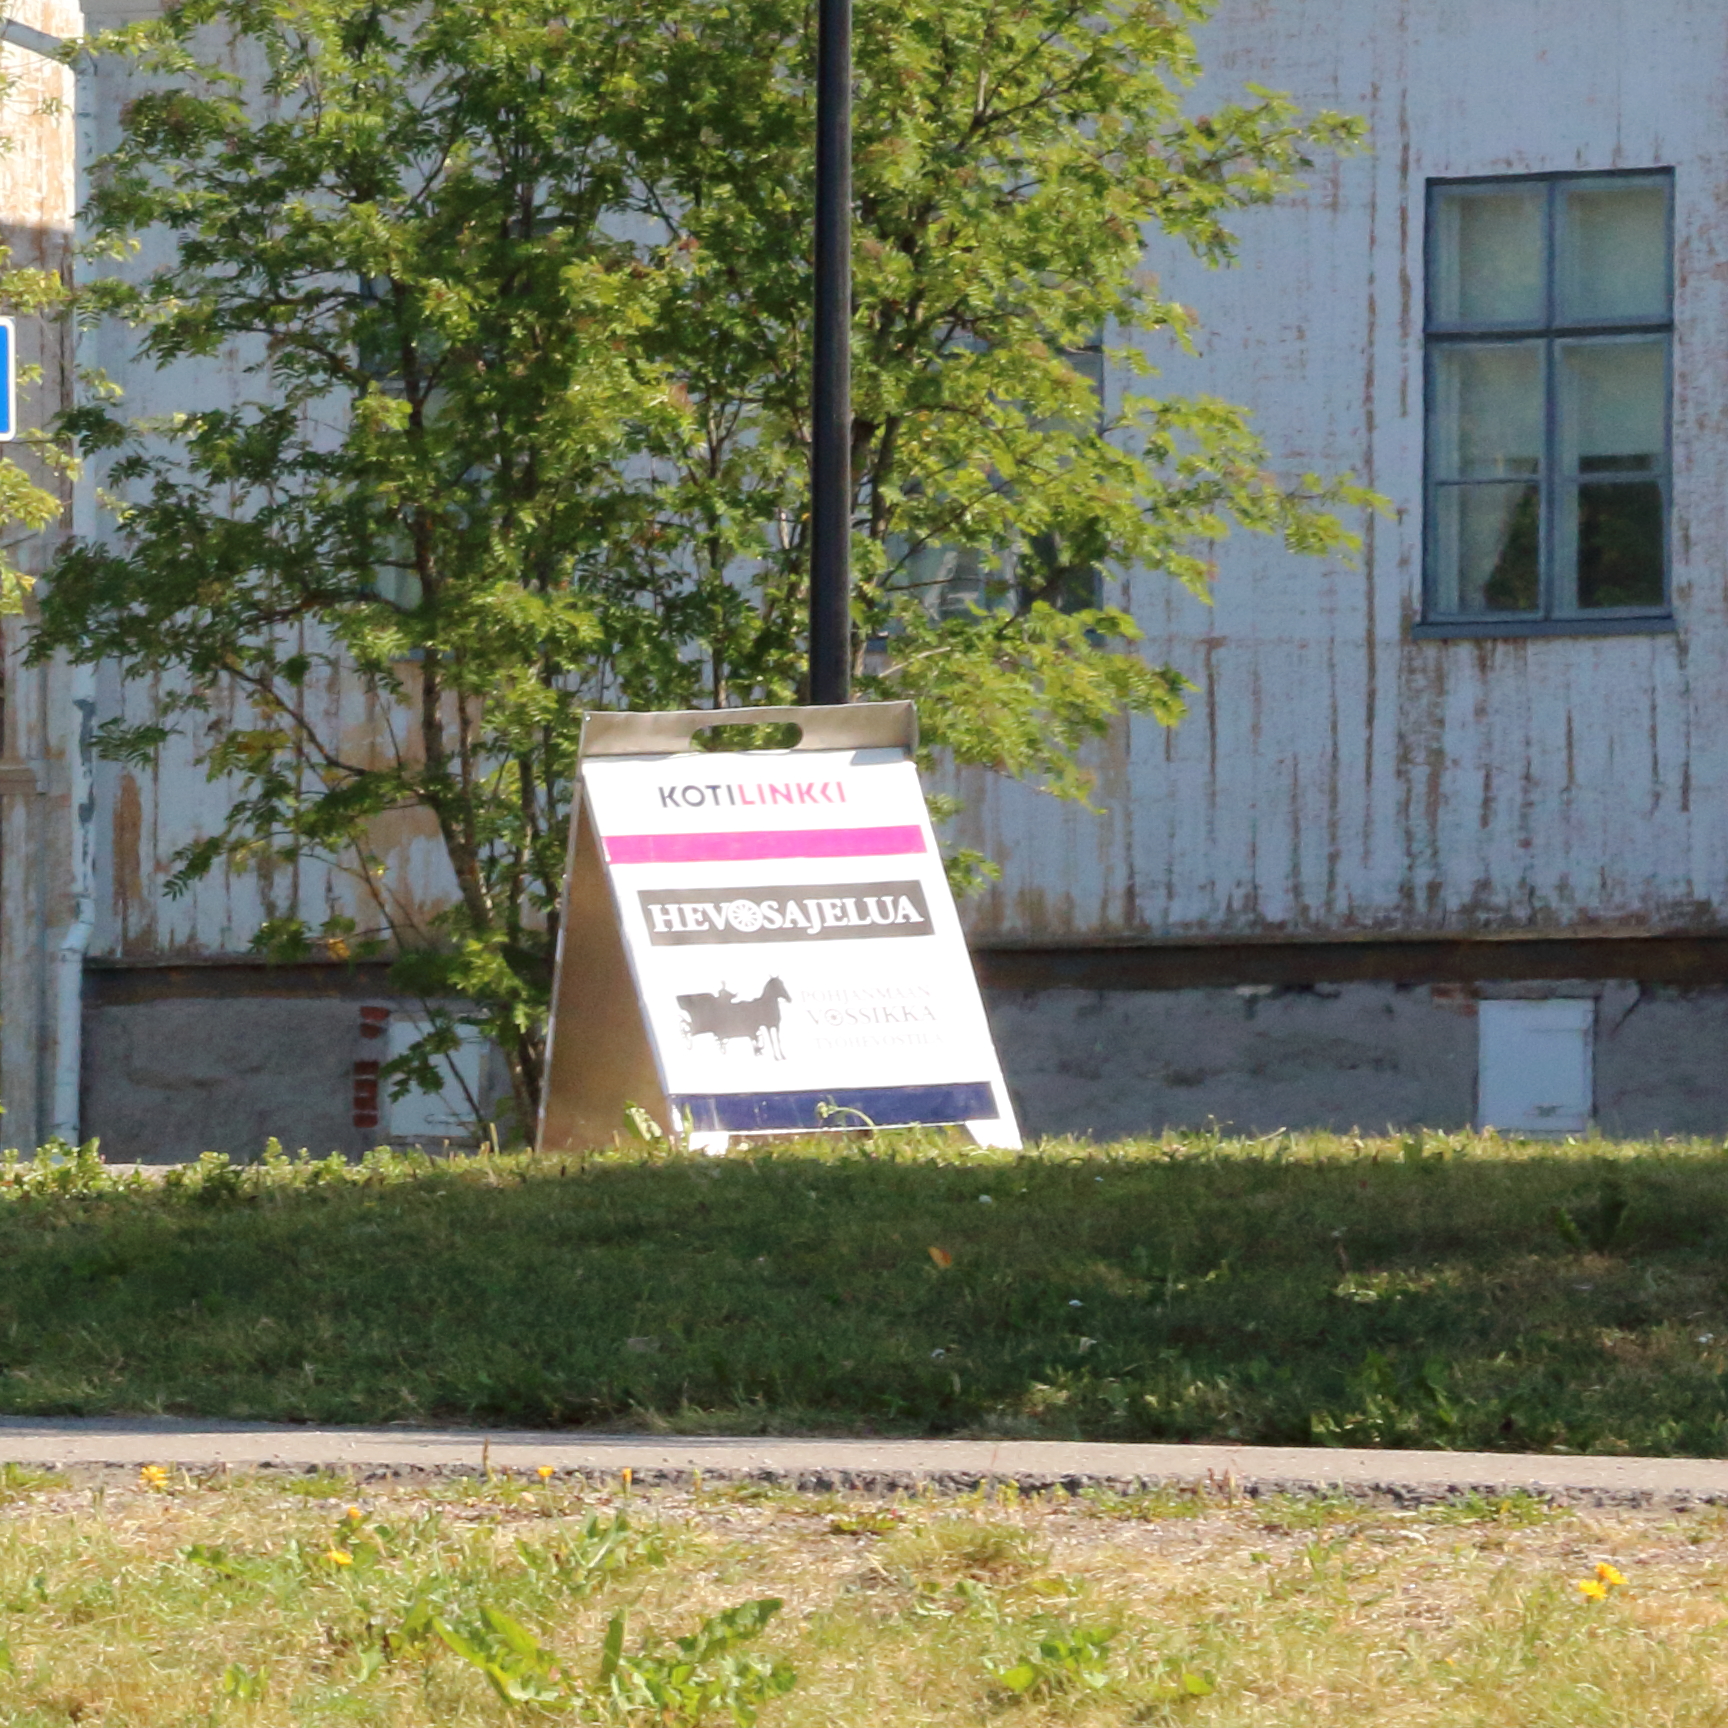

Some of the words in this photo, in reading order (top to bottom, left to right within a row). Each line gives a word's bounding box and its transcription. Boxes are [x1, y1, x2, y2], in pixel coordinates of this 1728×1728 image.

[648, 894, 924, 935] HEVOSAJELUA
[800, 985, 931, 1005] POHJANMAAN
[806, 1005, 937, 1027] VOSSIKKA
